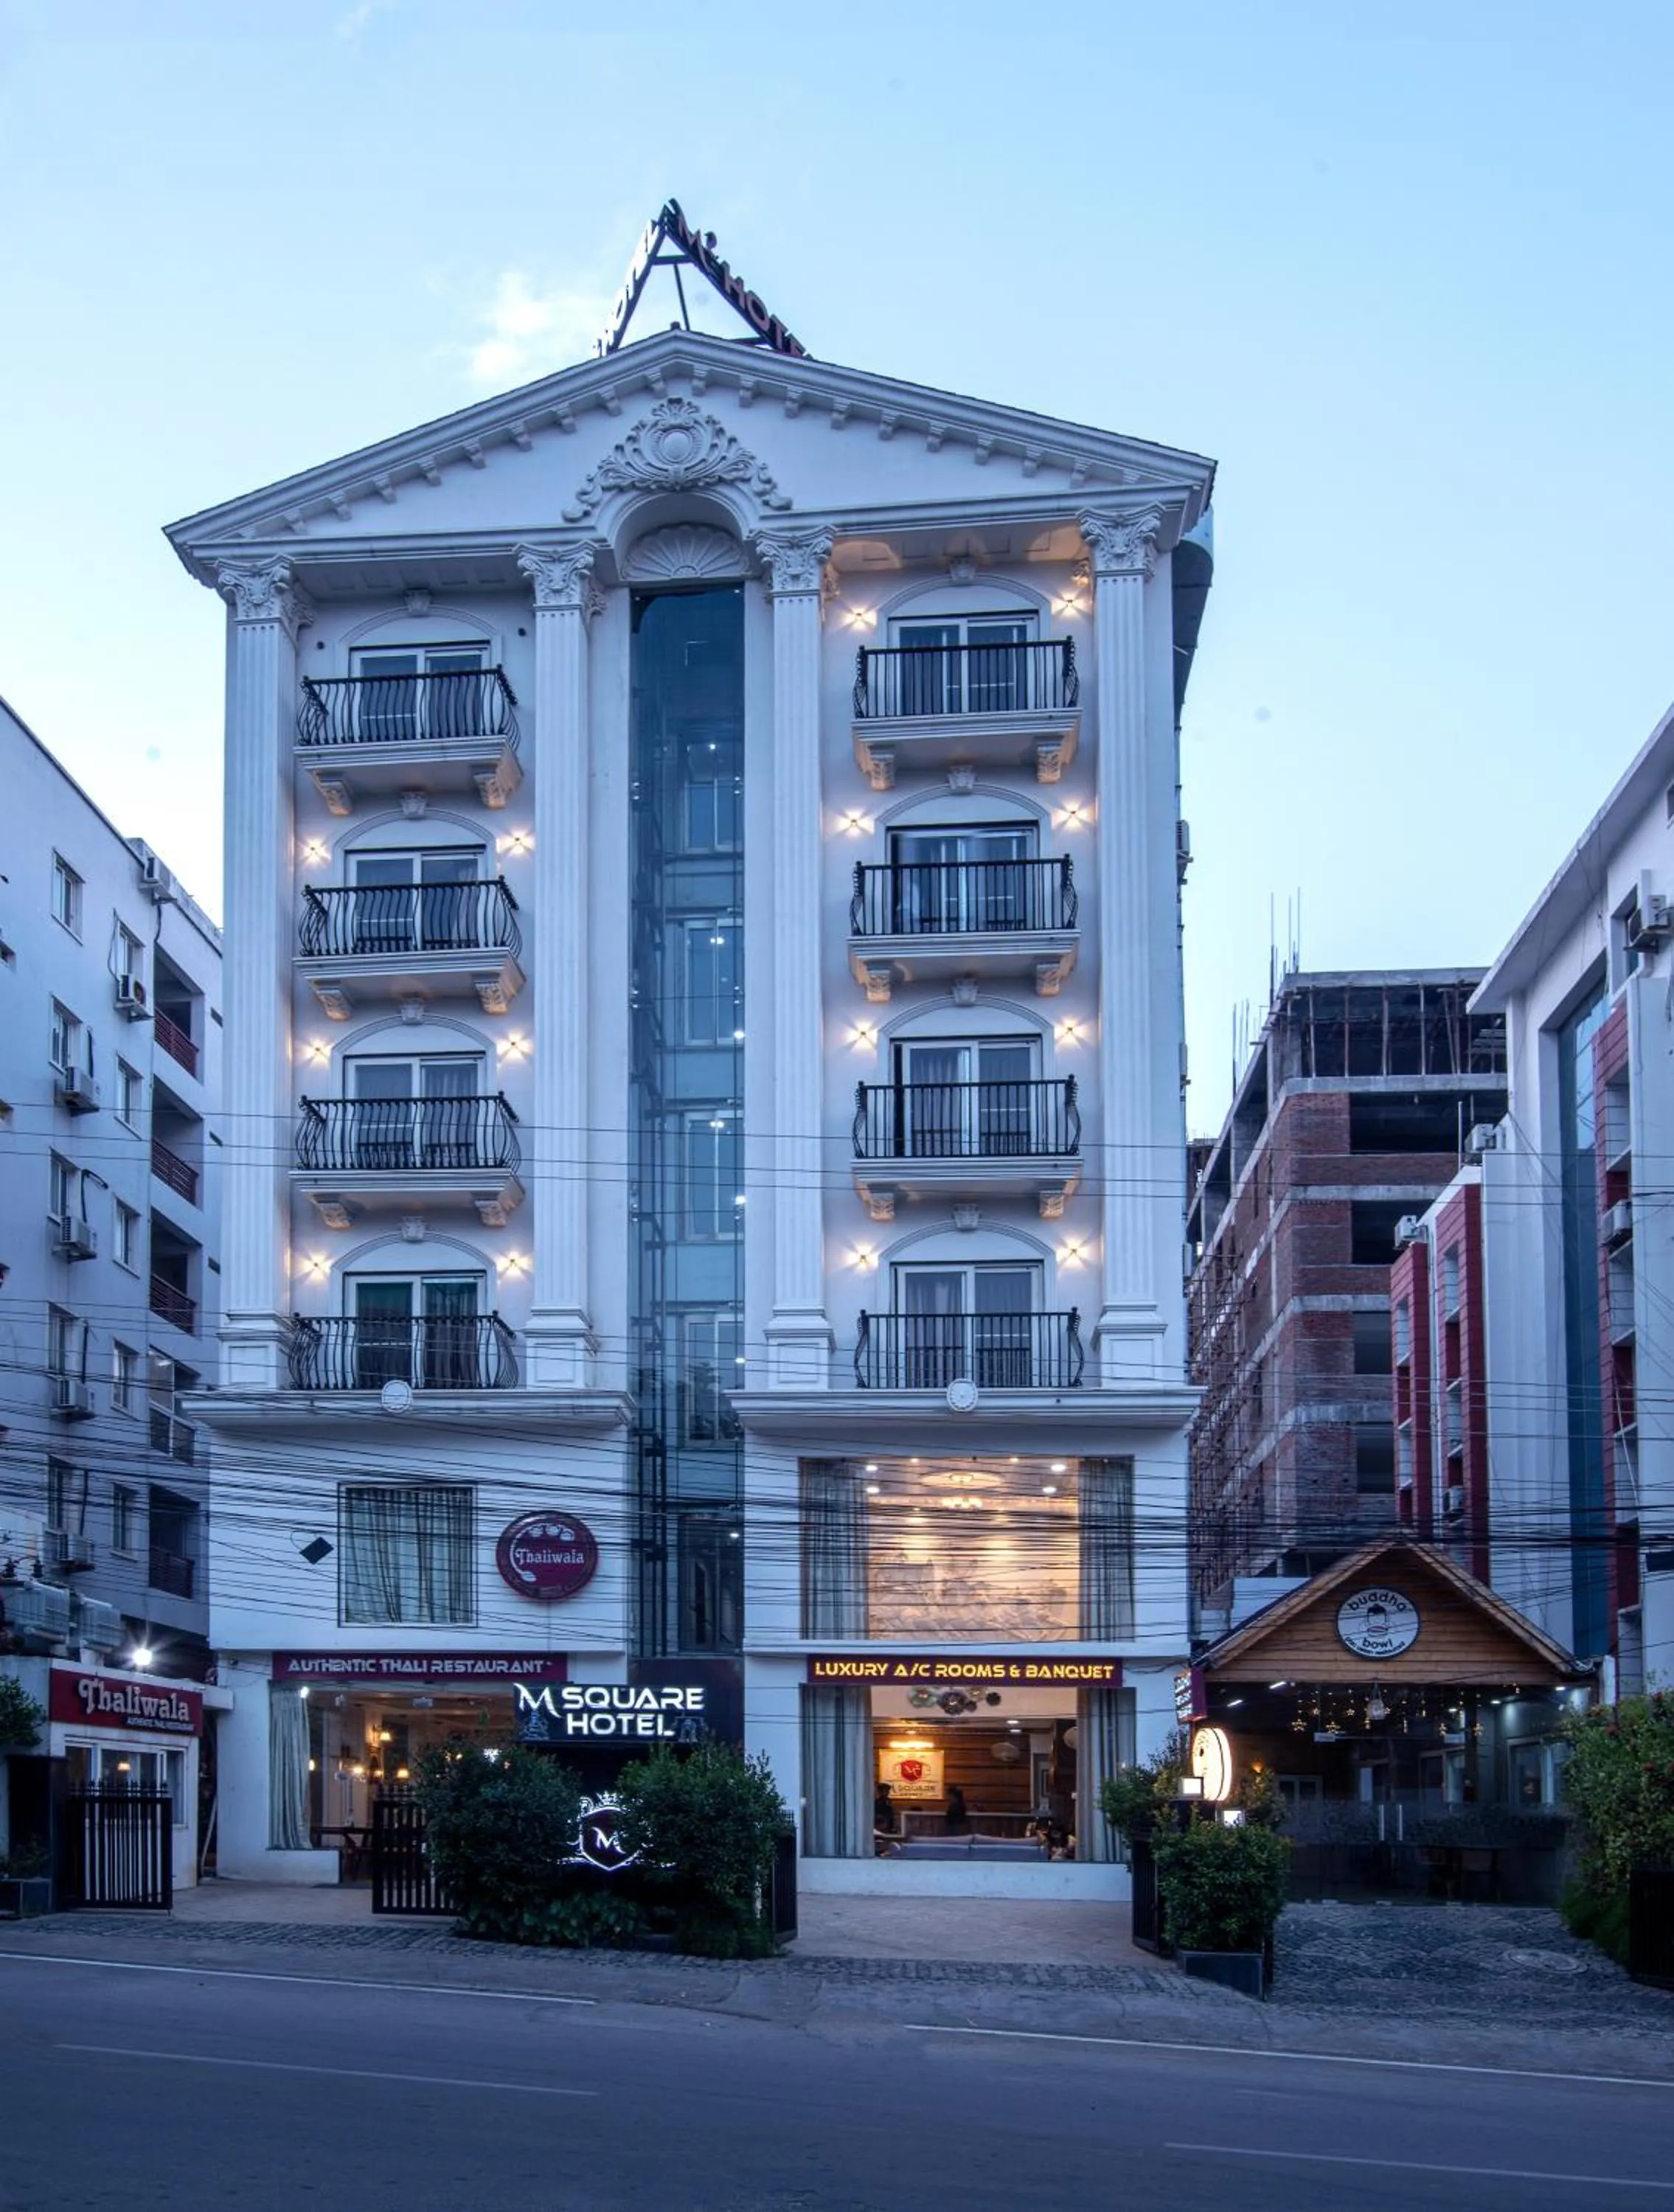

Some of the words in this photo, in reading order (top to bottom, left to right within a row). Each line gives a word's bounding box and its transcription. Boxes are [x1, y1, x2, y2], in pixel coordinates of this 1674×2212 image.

[1347, 1591, 1407, 1612] buddha
[1362, 1637, 1393, 1649] bowl
[288, 1658, 377, 1672] AUTHENTIC
[379, 1659, 428, 1673] THALI
[431, 1660, 543, 1674] RESTAURANT
[815, 1662, 888, 1677] LUXURY
[894, 1663, 931, 1677] A/C
[934, 1664, 1005, 1678] ROOMS
[1009, 1665, 1020, 1678] &
[1026, 1664, 1114, 1680] BANQUET
[78, 1677, 190, 1722] Thaliwala
[513, 1682, 562, 1719] M
[562, 1687, 705, 1710] SQUARE
[567, 1713, 675, 1736] HOTEL
